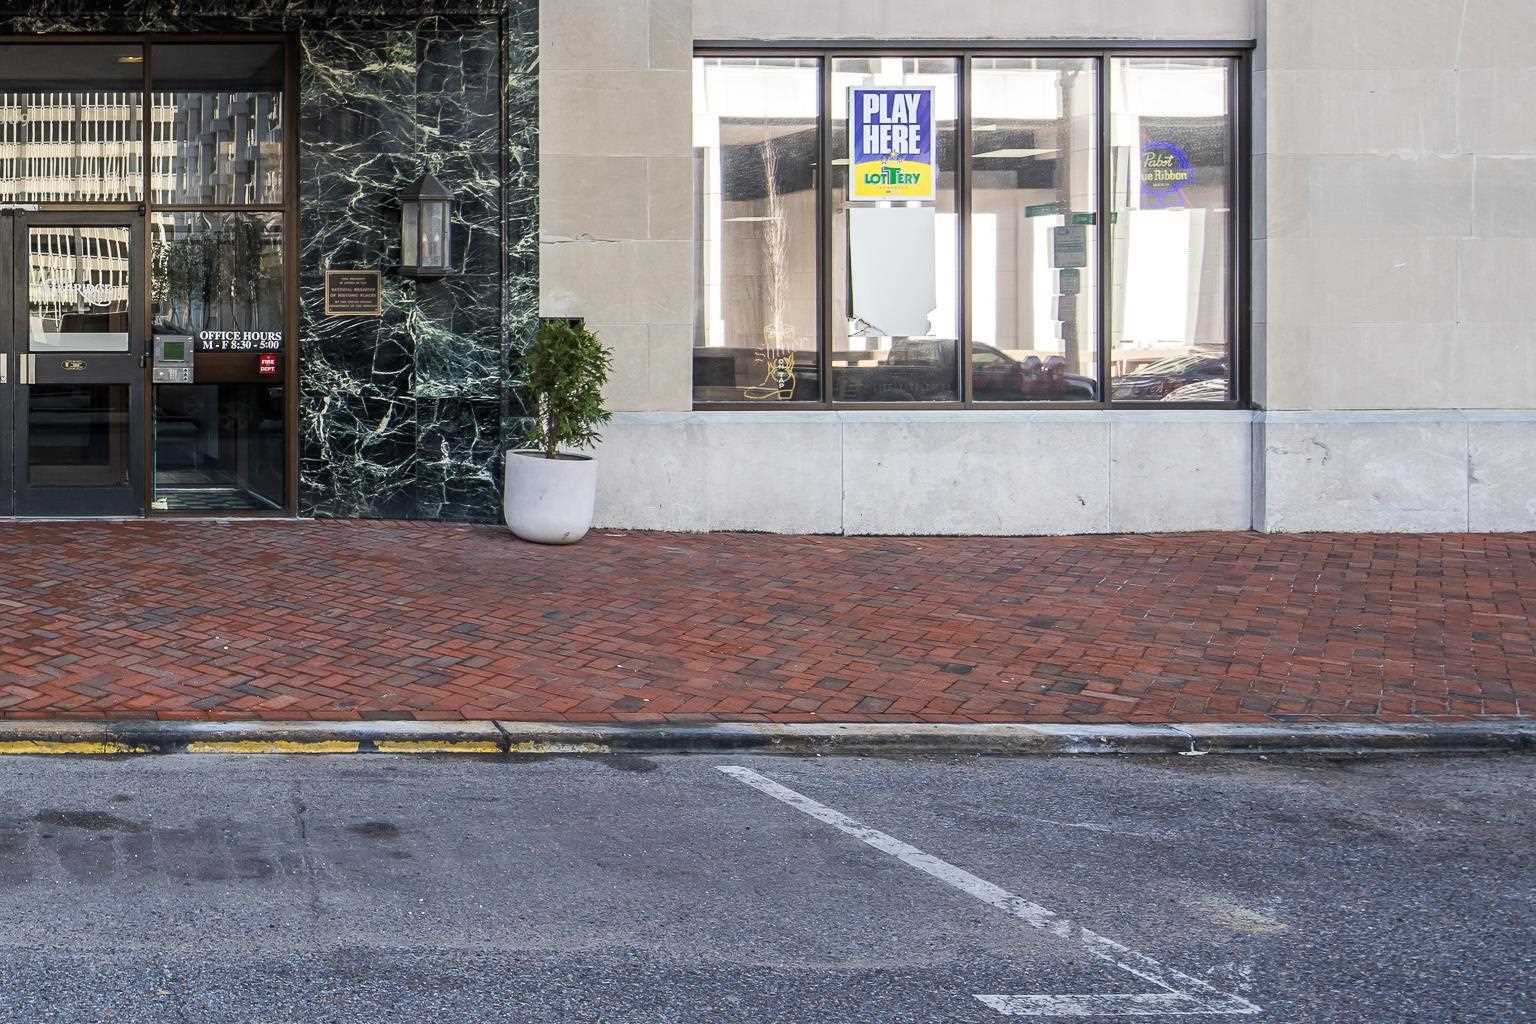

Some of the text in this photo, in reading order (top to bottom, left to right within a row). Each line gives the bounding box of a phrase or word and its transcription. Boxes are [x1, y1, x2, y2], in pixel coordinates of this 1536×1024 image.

[863, 93, 922, 124] PLAY
[863, 124, 921, 154] HERE
[1144, 151, 1174, 168] Pabst
[865, 167, 921, 184] LOTTERY
[1153, 169, 1188, 181] Ribbon
[199, 331, 282, 341] OFFICE HOURS
[202, 341, 214, 349] M
[221, 341, 229, 349] F
[230, 341, 252, 349] 8:30
[259, 341, 280, 349] 5:00
